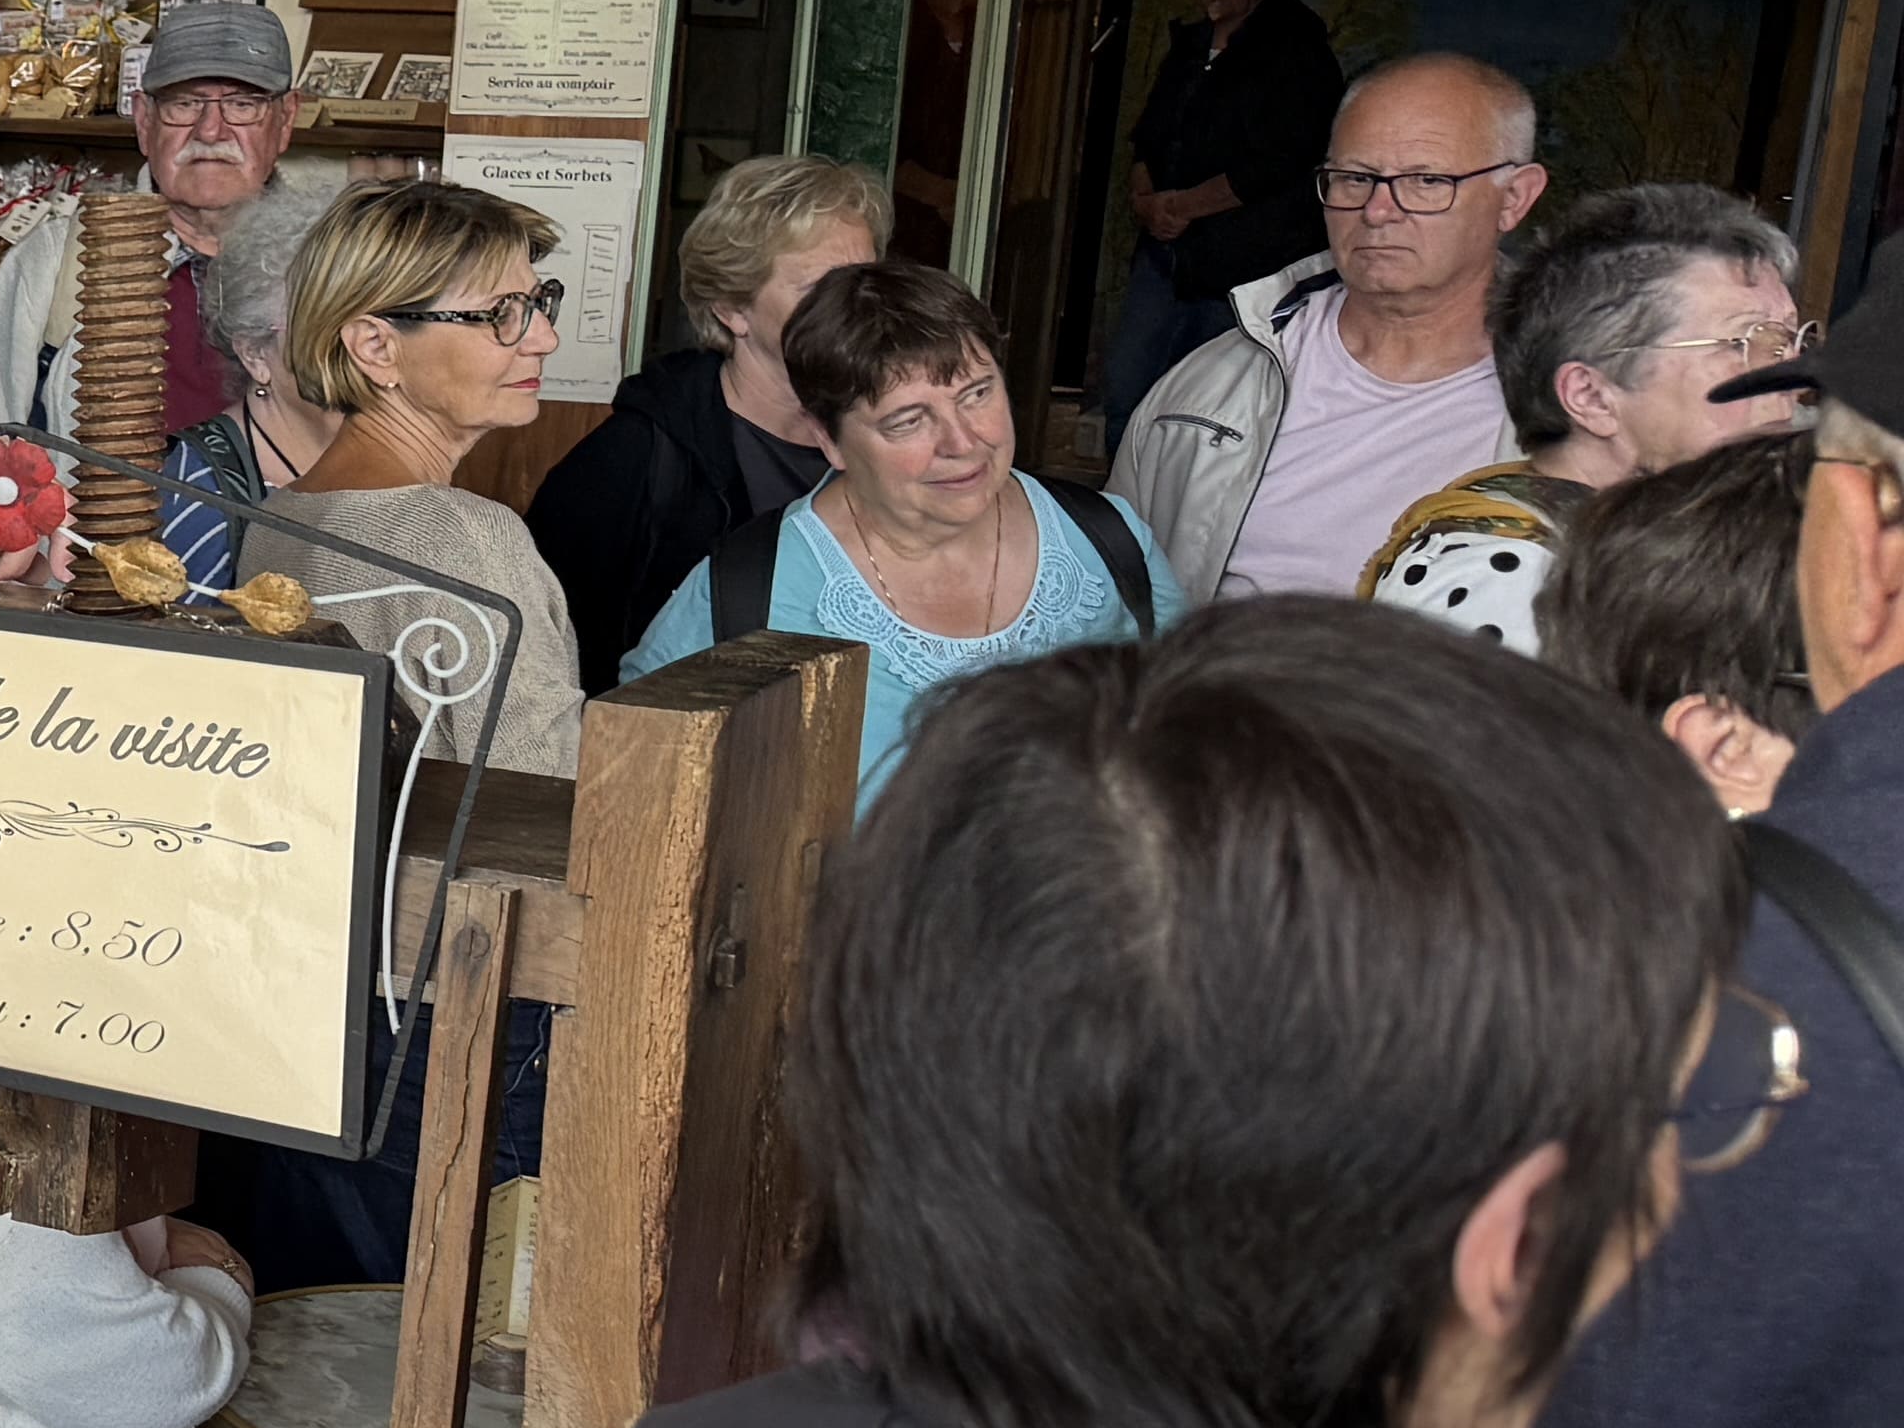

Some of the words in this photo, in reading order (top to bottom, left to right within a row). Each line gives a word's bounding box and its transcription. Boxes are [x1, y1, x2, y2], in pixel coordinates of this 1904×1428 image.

[488, 76, 534, 90] Service
[536, 78, 553, 90] au
[556, 78, 616, 93] comptoir
[482, 165, 533, 181] Glaces
[536, 167, 551, 181] et
[554, 167, 613, 183] Sorbets
[30, 686, 101, 756] la
[112, 715, 272, 779] visite
